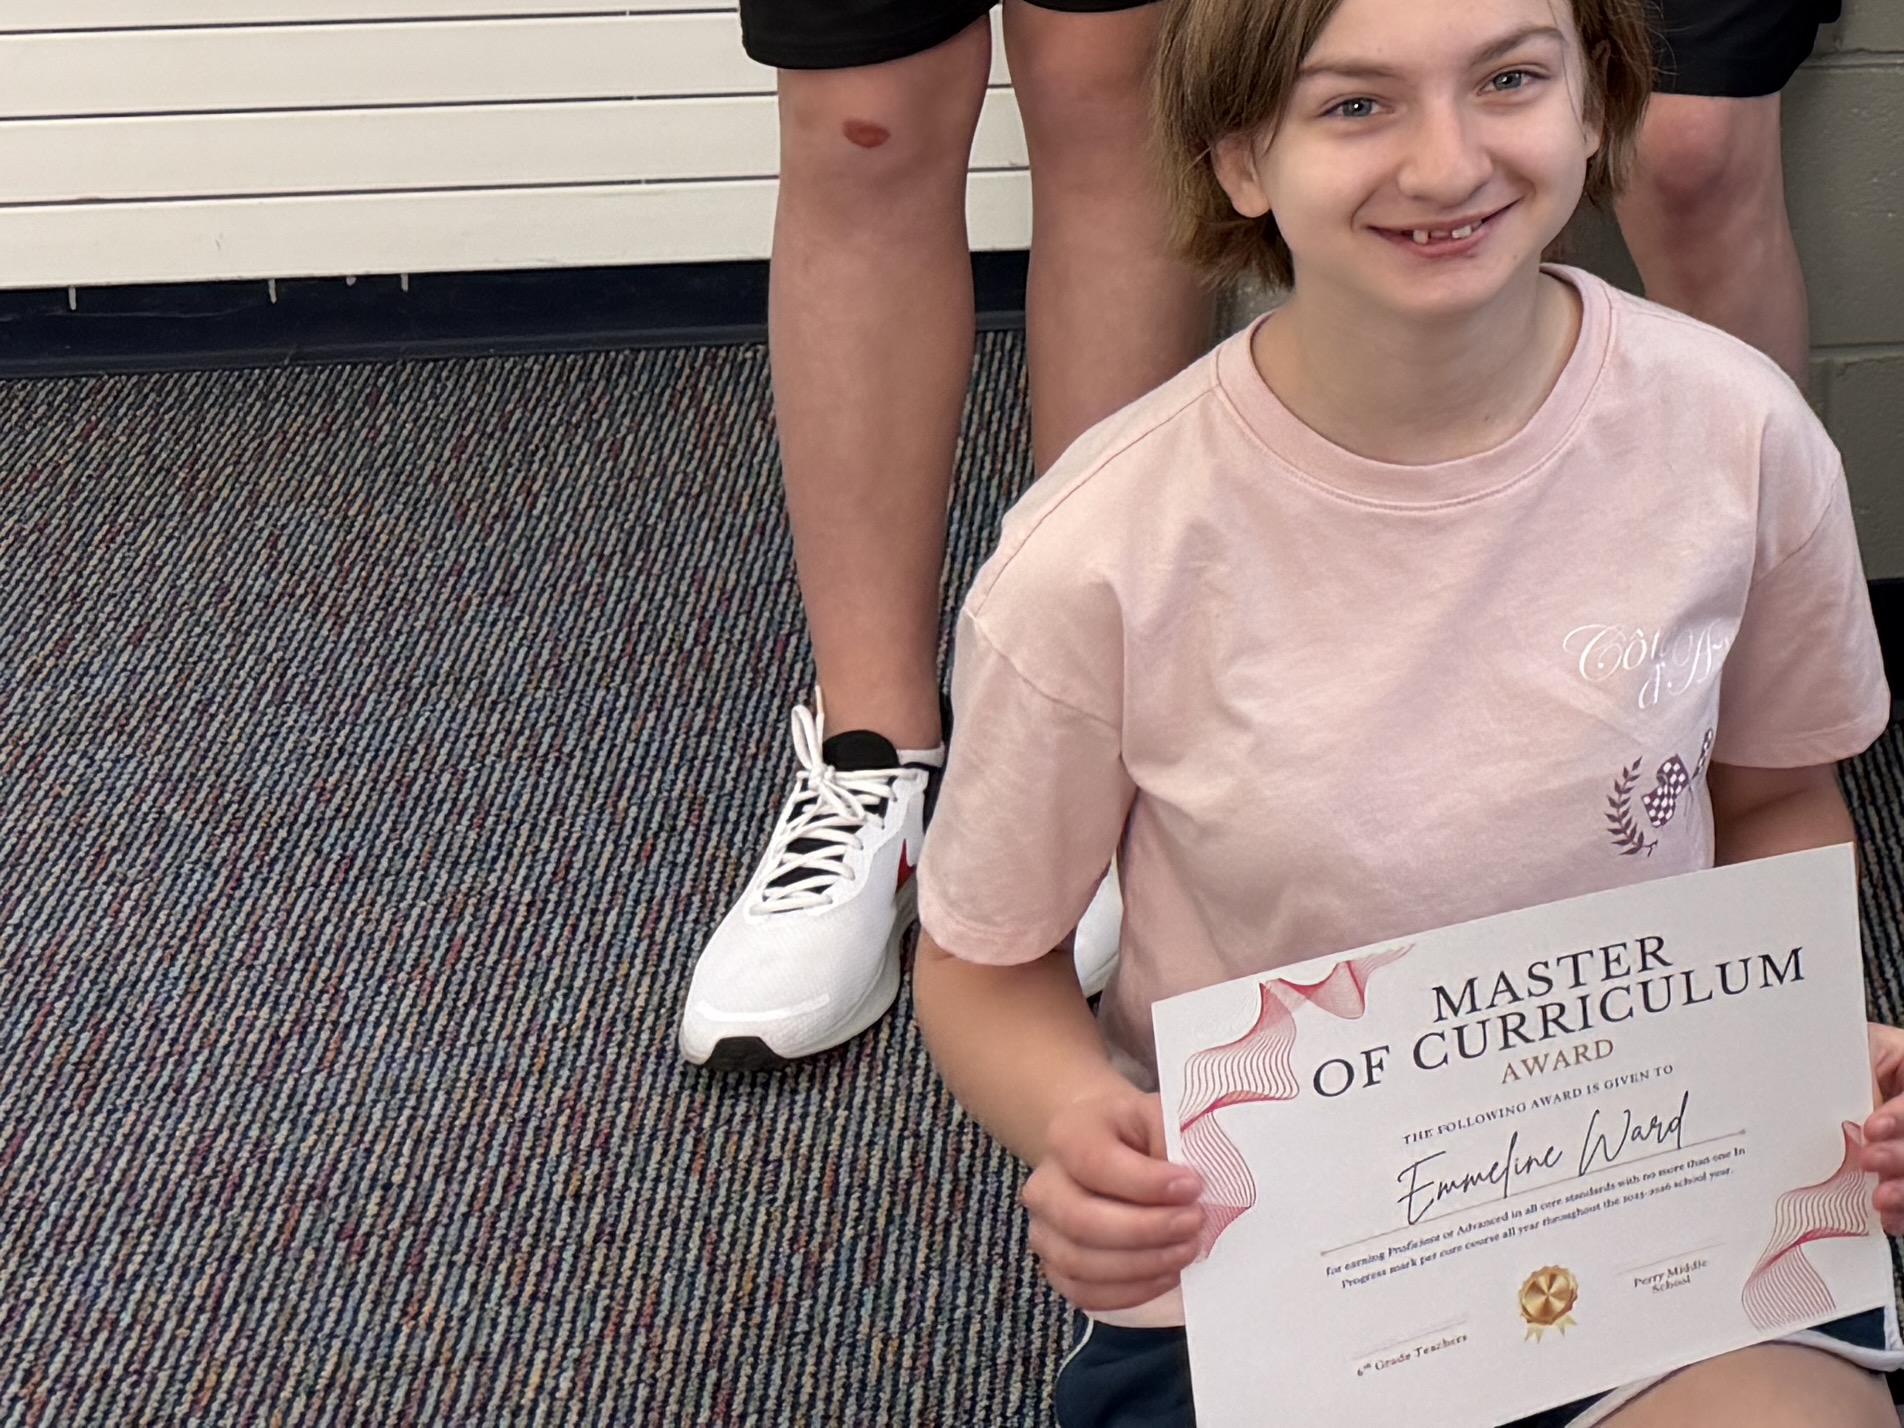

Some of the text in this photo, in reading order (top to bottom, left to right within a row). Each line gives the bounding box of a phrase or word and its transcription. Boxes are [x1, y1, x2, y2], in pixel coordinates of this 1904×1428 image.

[1313, 946, 1804, 1096] OF CURRICULUM
[1432, 936, 1672, 1022] MASTER
[1403, 1063, 1673, 1145] THE FOLLOWING AWARD IS GIVEN TO
[1502, 1039, 1613, 1084] AWARD
[1396, 1090, 1689, 1226] Emmeline Ward
